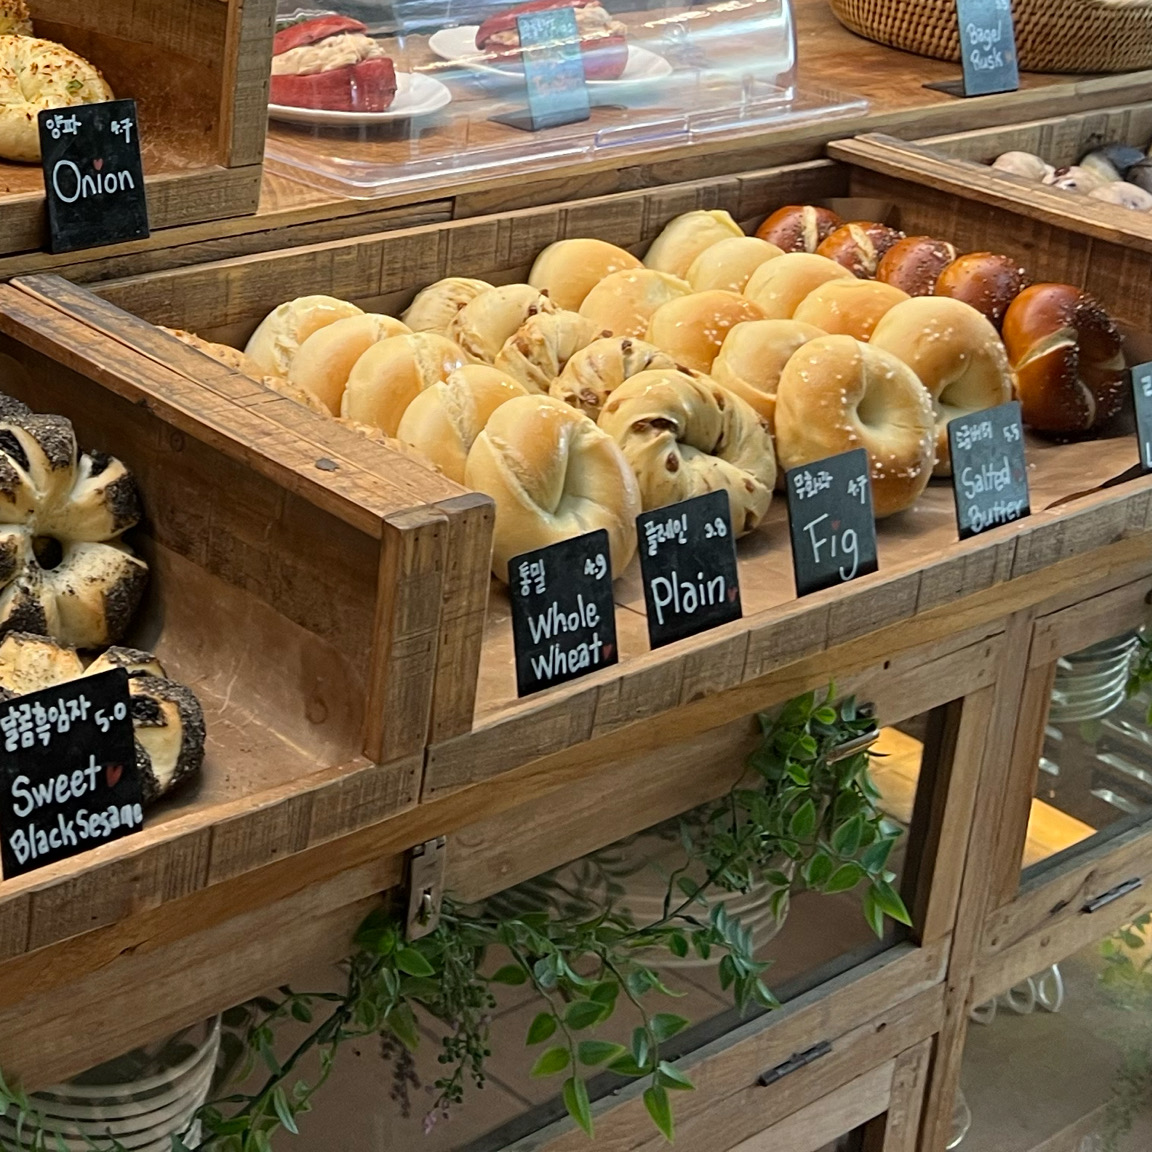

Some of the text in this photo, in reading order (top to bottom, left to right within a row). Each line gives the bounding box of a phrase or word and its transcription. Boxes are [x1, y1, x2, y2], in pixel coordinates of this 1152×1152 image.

[966, 19, 1002, 52] Bagel
[45, 114, 82, 139] 양파
[52, 159, 135, 203] Onion
[793, 470, 834, 500] 무화과
[961, 455, 1011, 500] Salted
[644, 513, 727, 556] 플레인 3.8
[967, 499, 1023, 533] Butter
[803, 512, 859, 581] Fig
[518, 553, 607, 597] 통밀 4.9
[528, 593, 600, 645] Whole
[651, 570, 726, 625] Plain
[530, 632, 603, 680] Wheat
[94, 702, 127, 733] 5.0
[11, 754, 102, 818] Sweet
